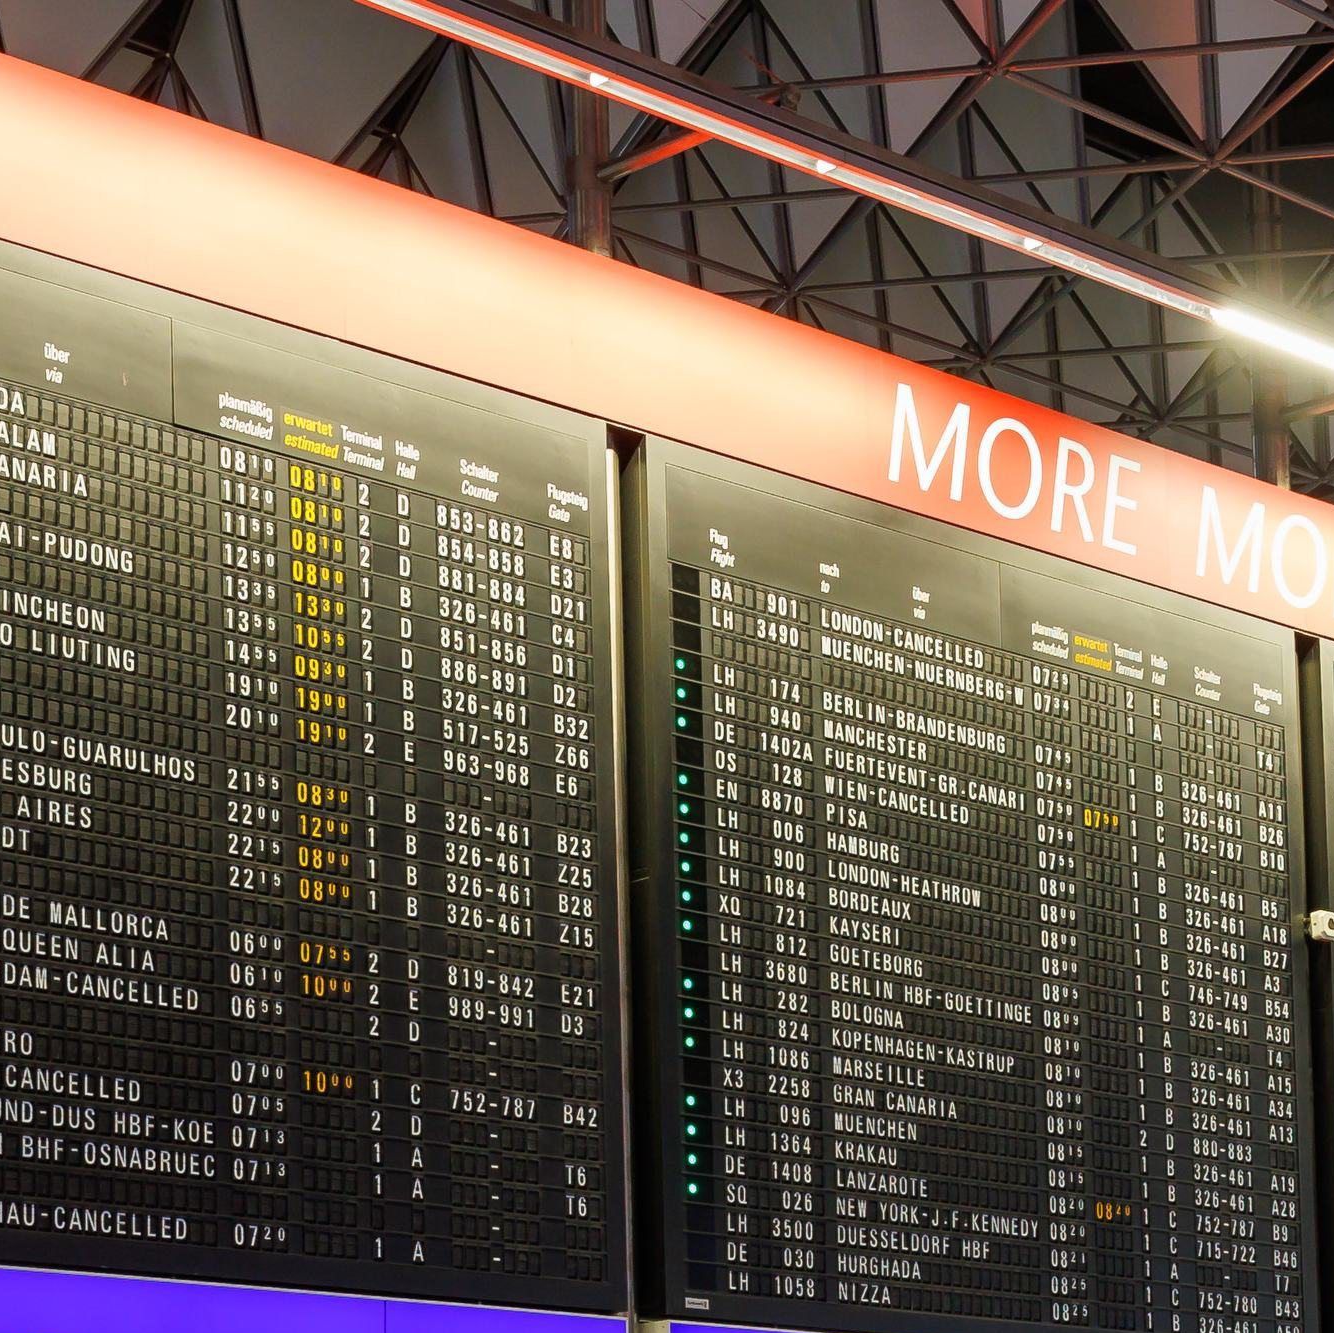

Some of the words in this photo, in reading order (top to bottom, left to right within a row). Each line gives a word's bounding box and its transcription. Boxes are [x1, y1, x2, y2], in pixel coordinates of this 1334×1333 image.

[44, 342, 70, 364] über
[46, 365, 63, 384] via
[218, 392, 273, 422] planmäßig
[219, 413, 273, 441] scheduled
[284, 411, 333, 438] erwartet
[341, 425, 383, 450] Terminal
[284, 431, 339, 460] estimated
[343, 446, 384, 472] Terminal
[395, 439, 420, 462] Halle
[396, 461, 416, 480] Hall
[460, 458, 499, 484] Schalter
[887, 382, 1142, 556] MORE
[462, 480, 499, 504] Counter
[547, 482, 588, 511] Flugsteig
[548, 505, 570, 523] Gate
[32, 630, 134, 671] LIUTING
[360, 608, 371, 629] 2
[400, 617, 412, 638] D
[440, 627, 526, 666] 851-856
[552, 654, 573, 677] D1
[821, 609, 983, 668] LONDON-CANCELLED
[823, 692, 1005, 753] BERLIN-BRANDENBURG
[823, 720, 926, 761] MANCHESTER
[17, 796, 91, 828] AIRES
[826, 803, 867, 829] PISA
[826, 832, 899, 863] HAMBURG
[828, 860, 980, 906] LONDON-HEATHROW
[2, 895, 30, 919] DE
[49, 902, 168, 940] MALLORCA
[828, 888, 911, 920] BORDEAUX
[95, 943, 154, 971] ALIA
[832, 1029, 1014, 1072] KOPENHAGEN-KASTRUP
[114, 1112, 213, 1143] HBF-KOE
[22, 1136, 214, 1176] BHF-OSNABRUEC
[838, 1282, 890, 1304] NIZZA
